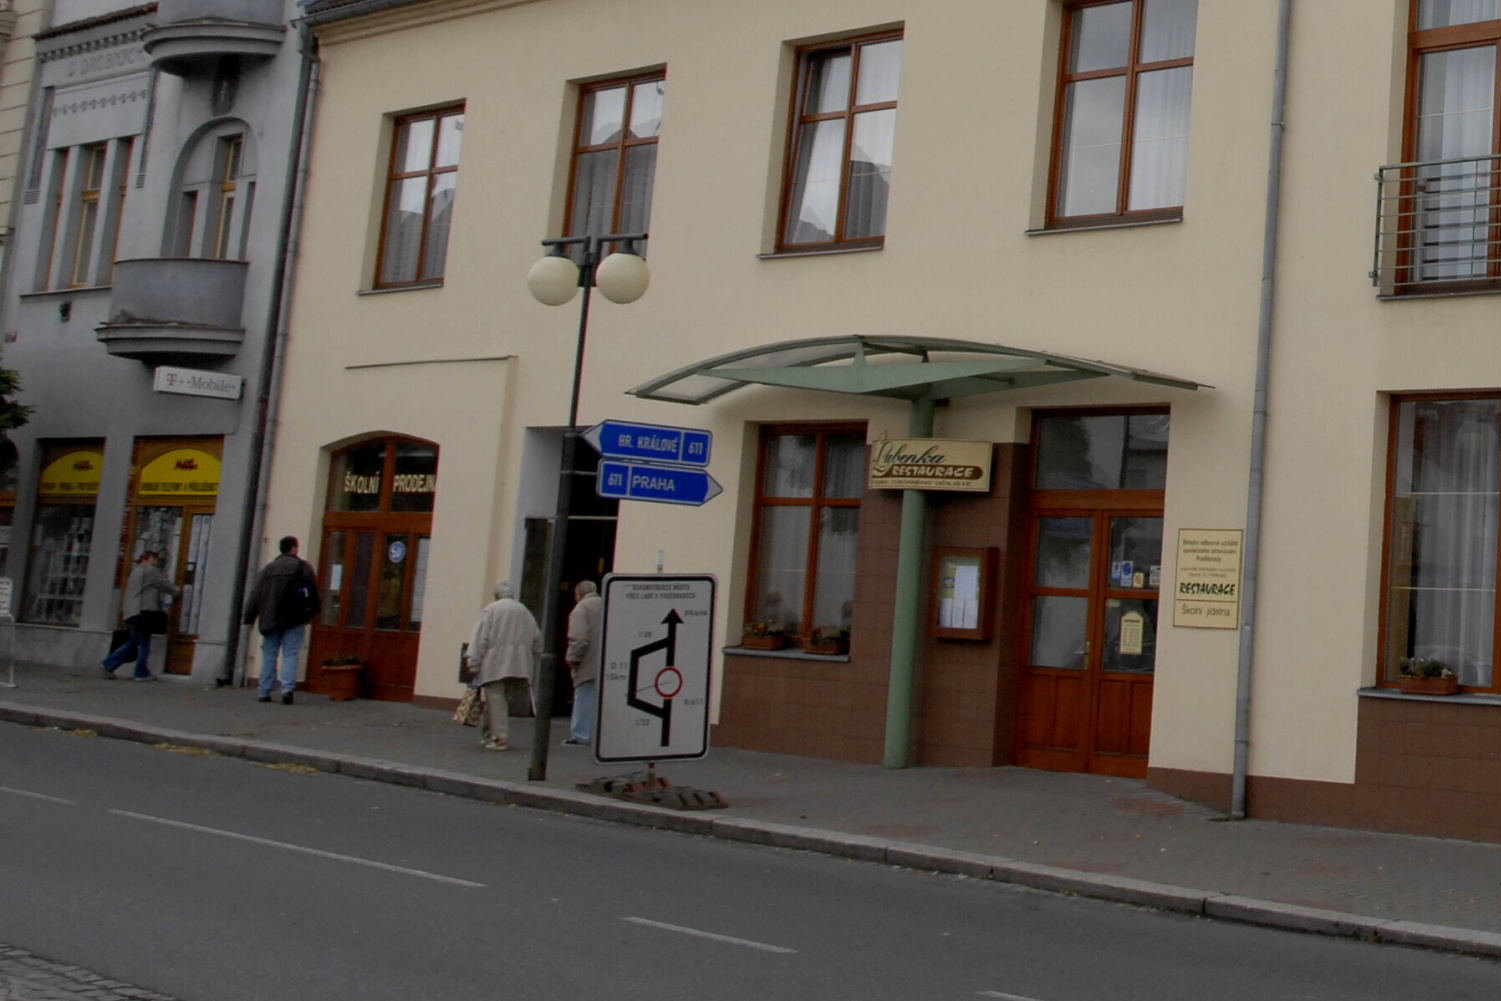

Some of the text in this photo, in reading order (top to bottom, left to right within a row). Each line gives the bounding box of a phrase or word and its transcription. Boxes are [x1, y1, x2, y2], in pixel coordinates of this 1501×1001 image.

[618, 434, 703, 454] HR. KRÁLOVÉ 611
[892, 465, 973, 477] RESTAURACE
[344, 471, 380, 493] ŠKOLNÍ
[608, 473, 675, 491] 611 PRAHA
[1179, 582, 1236, 596] RESTAURACE
[1182, 603, 1230, 618] Školní jídelna
